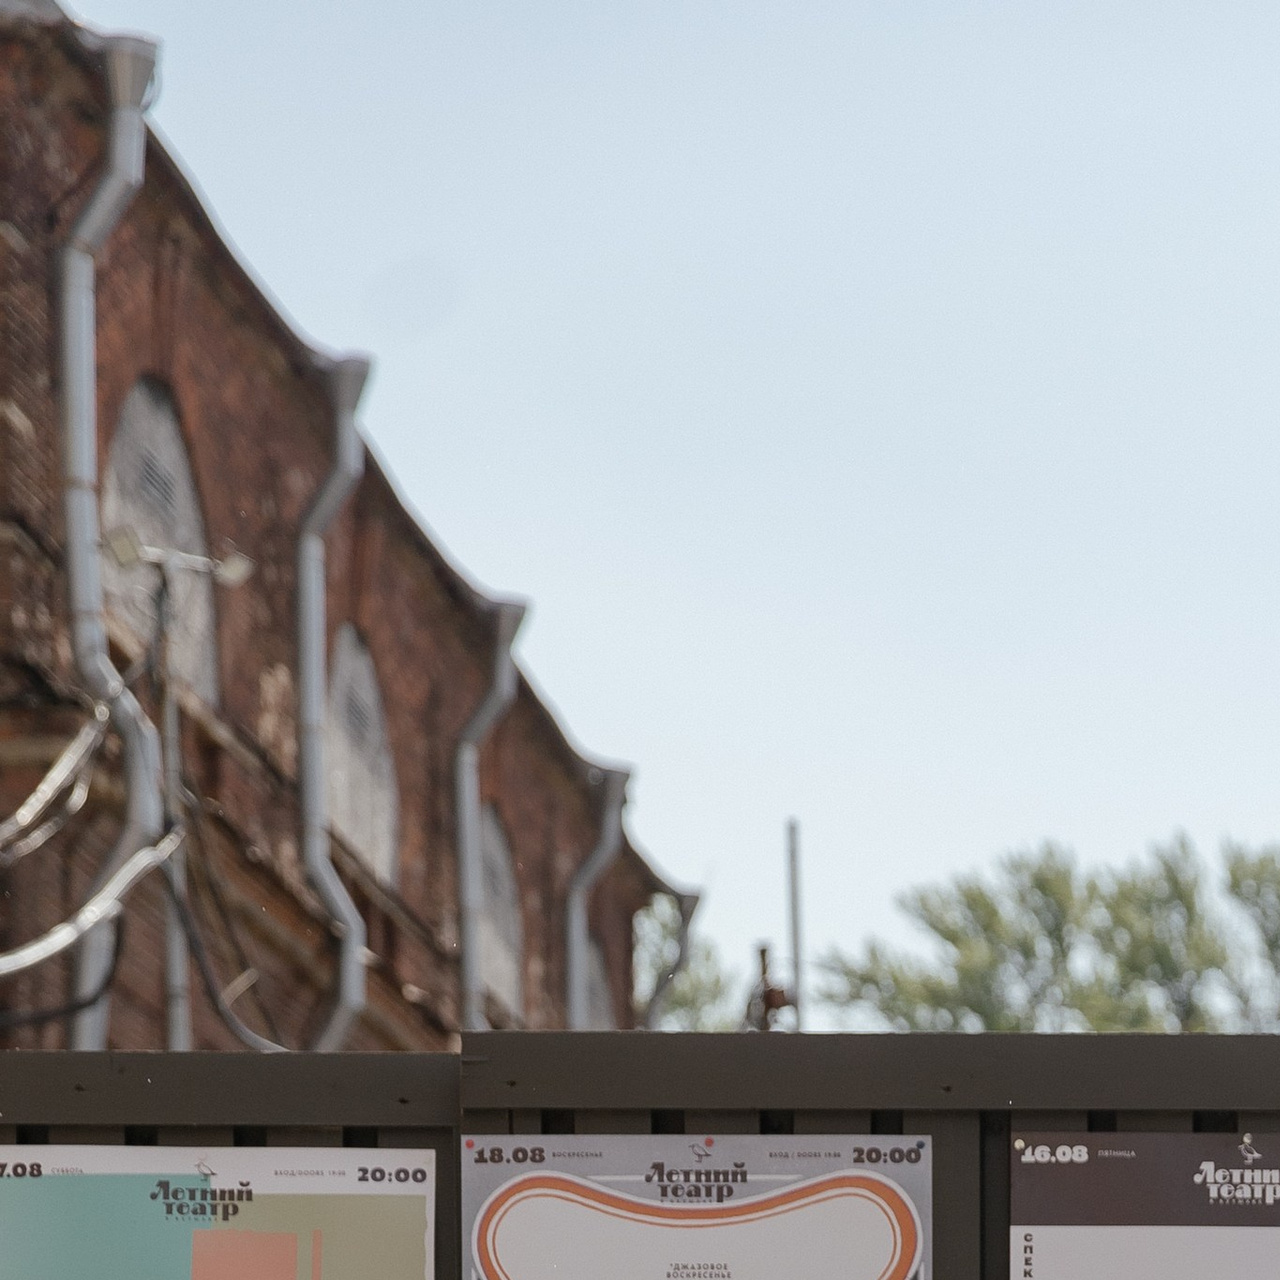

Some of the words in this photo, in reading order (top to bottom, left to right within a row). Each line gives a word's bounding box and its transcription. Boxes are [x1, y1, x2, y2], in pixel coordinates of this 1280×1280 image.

[473, 1146, 546, 1164] 18.08
[852, 1147, 922, 1164] 20:00
[1020, 1145, 1089, 1164] 16.08
[357, 1166, 427, 1183] 20:00
[644, 1161, 748, 1183] Летний
[150, 1180, 253, 1201] Летний
[657, 1184, 734, 1203] театр
[163, 1202, 239, 1221] театр
